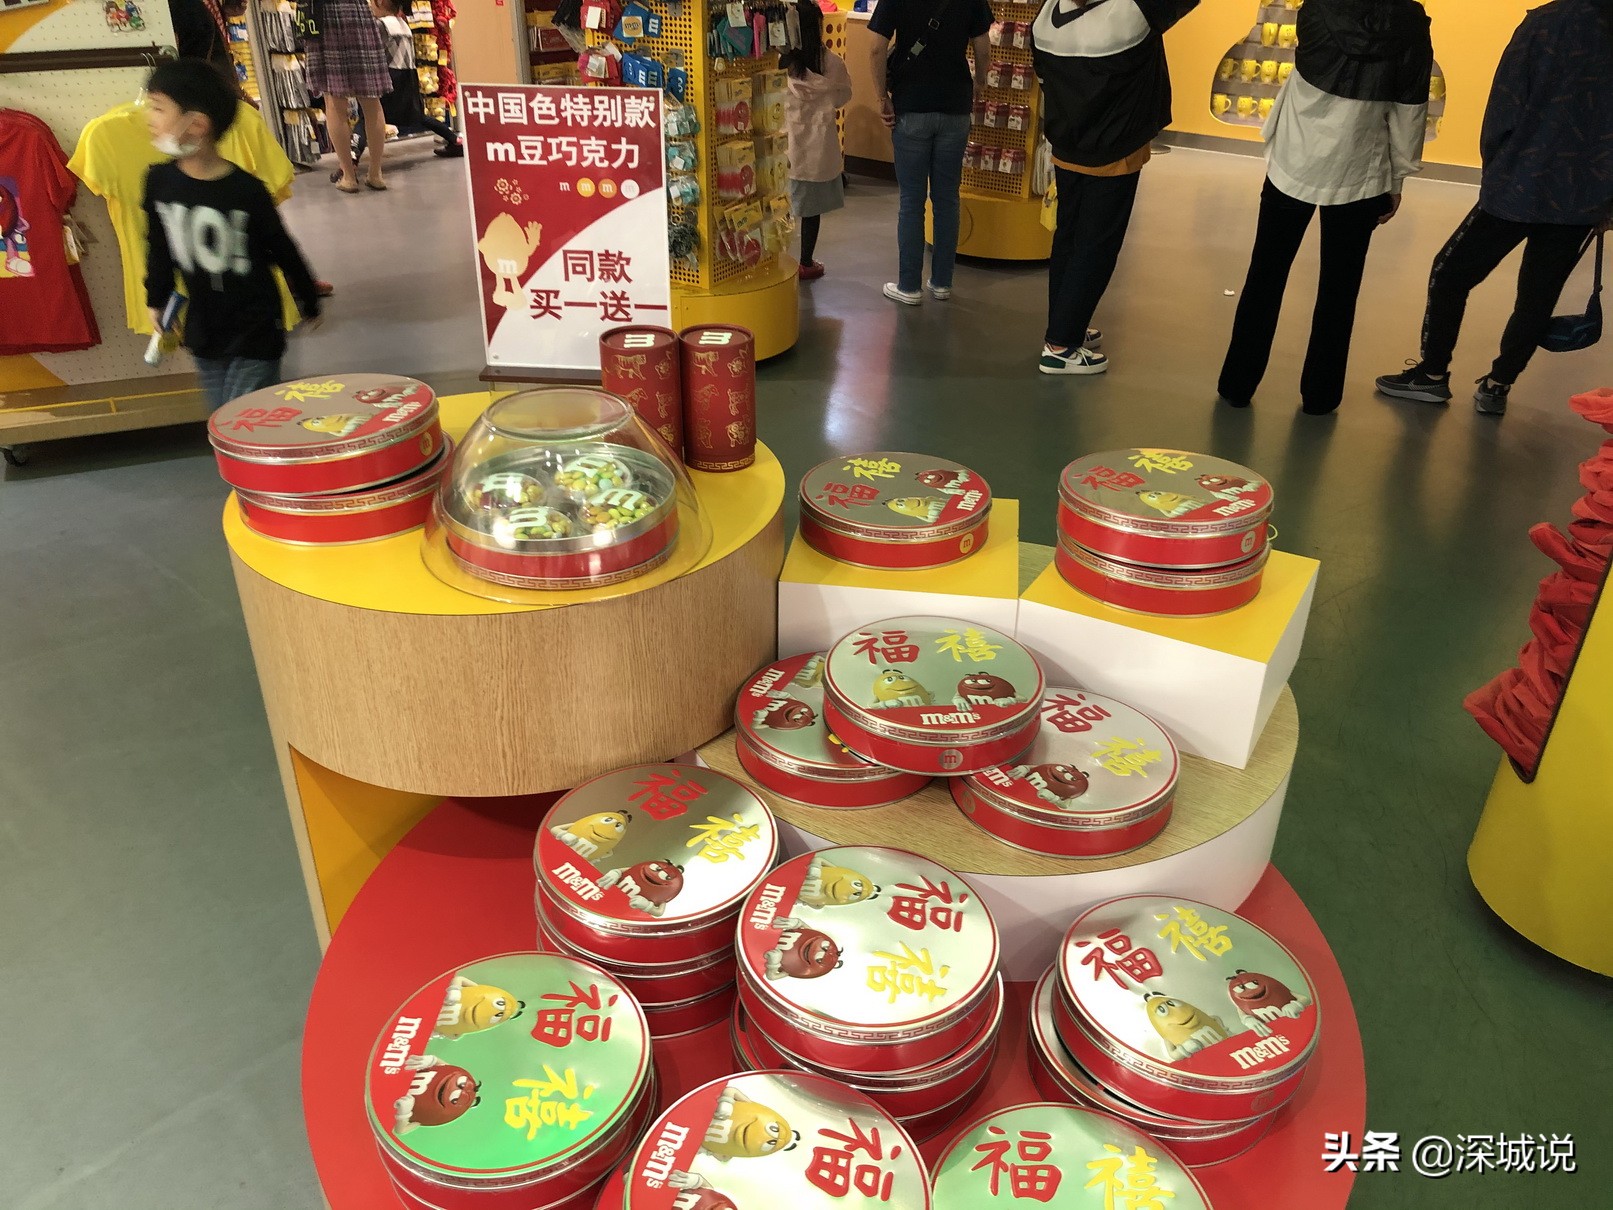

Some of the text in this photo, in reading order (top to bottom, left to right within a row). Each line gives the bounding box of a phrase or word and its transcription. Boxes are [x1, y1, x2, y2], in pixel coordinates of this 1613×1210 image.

[467, 91, 656, 128] 中国色特别款
[486, 135, 640, 169] m豆巧克力
[559, 182, 570, 191] m
[580, 183, 591, 191] m
[602, 184, 613, 192] m
[497, 258, 518, 274] m
[562, 249, 633, 283] 同款
[529, 288, 668, 322] 买一送一
[624, 333, 655, 348] m
[698, 331, 732, 345] m
[221, 407, 302, 432] 福
[1072, 465, 1146, 492] 福
[815, 482, 880, 510] 福
[852, 630, 920, 665] 福
[1039, 693, 1112, 733] 福
[627, 769, 709, 821] 福
[887, 875, 969, 932] 福
[1075, 928, 1164, 990] 福
[531, 980, 619, 1048] 福
[804, 1117, 902, 1202] 福
[970, 1125, 1063, 1203] 福
